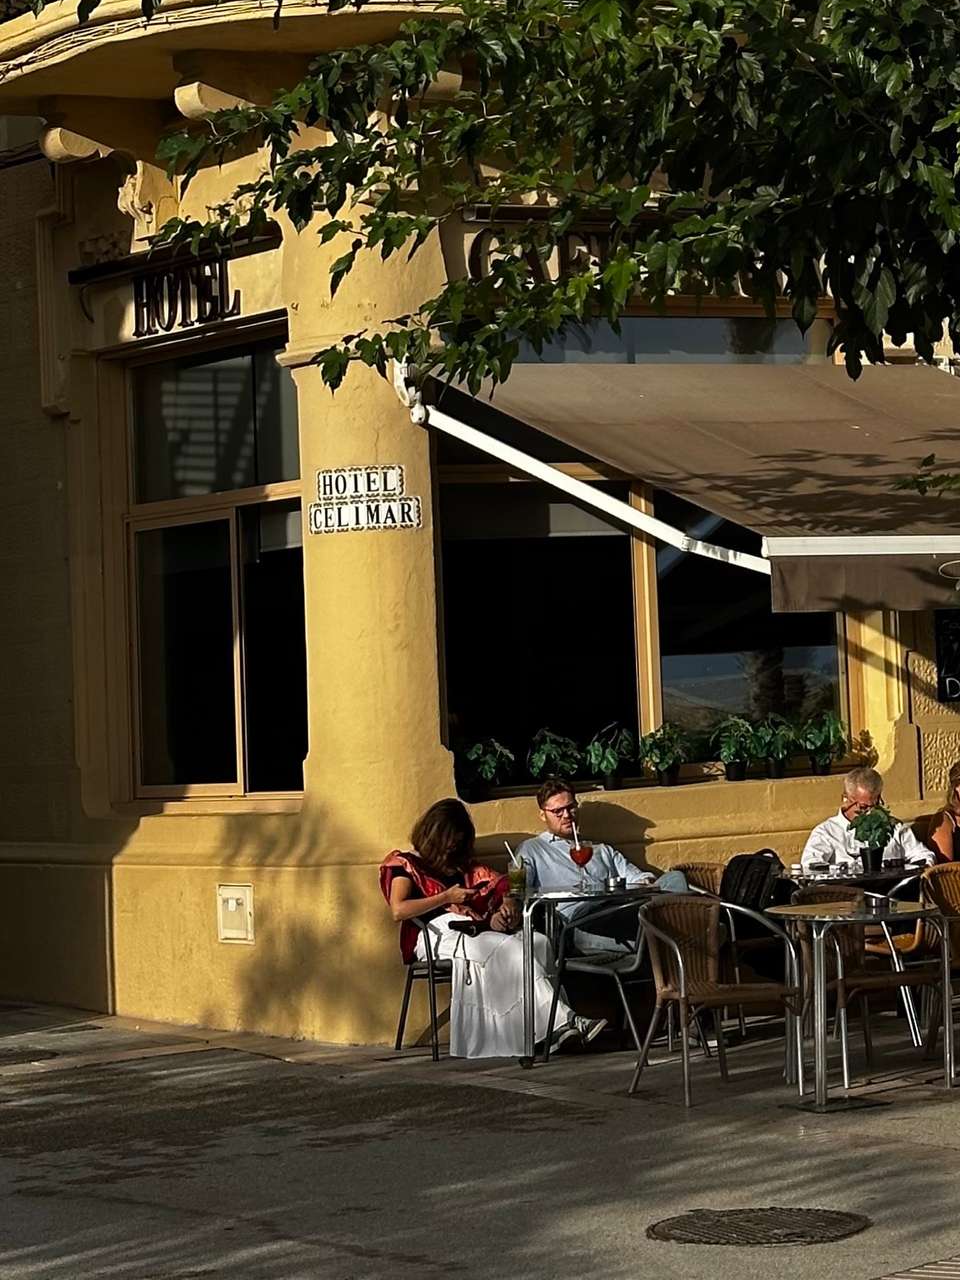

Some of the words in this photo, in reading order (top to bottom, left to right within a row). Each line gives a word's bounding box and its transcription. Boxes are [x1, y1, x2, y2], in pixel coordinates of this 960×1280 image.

[132, 260, 241, 338] HOTEL
[322, 471, 396, 495] HOTEL
[313, 502, 414, 529] CELIMAR
